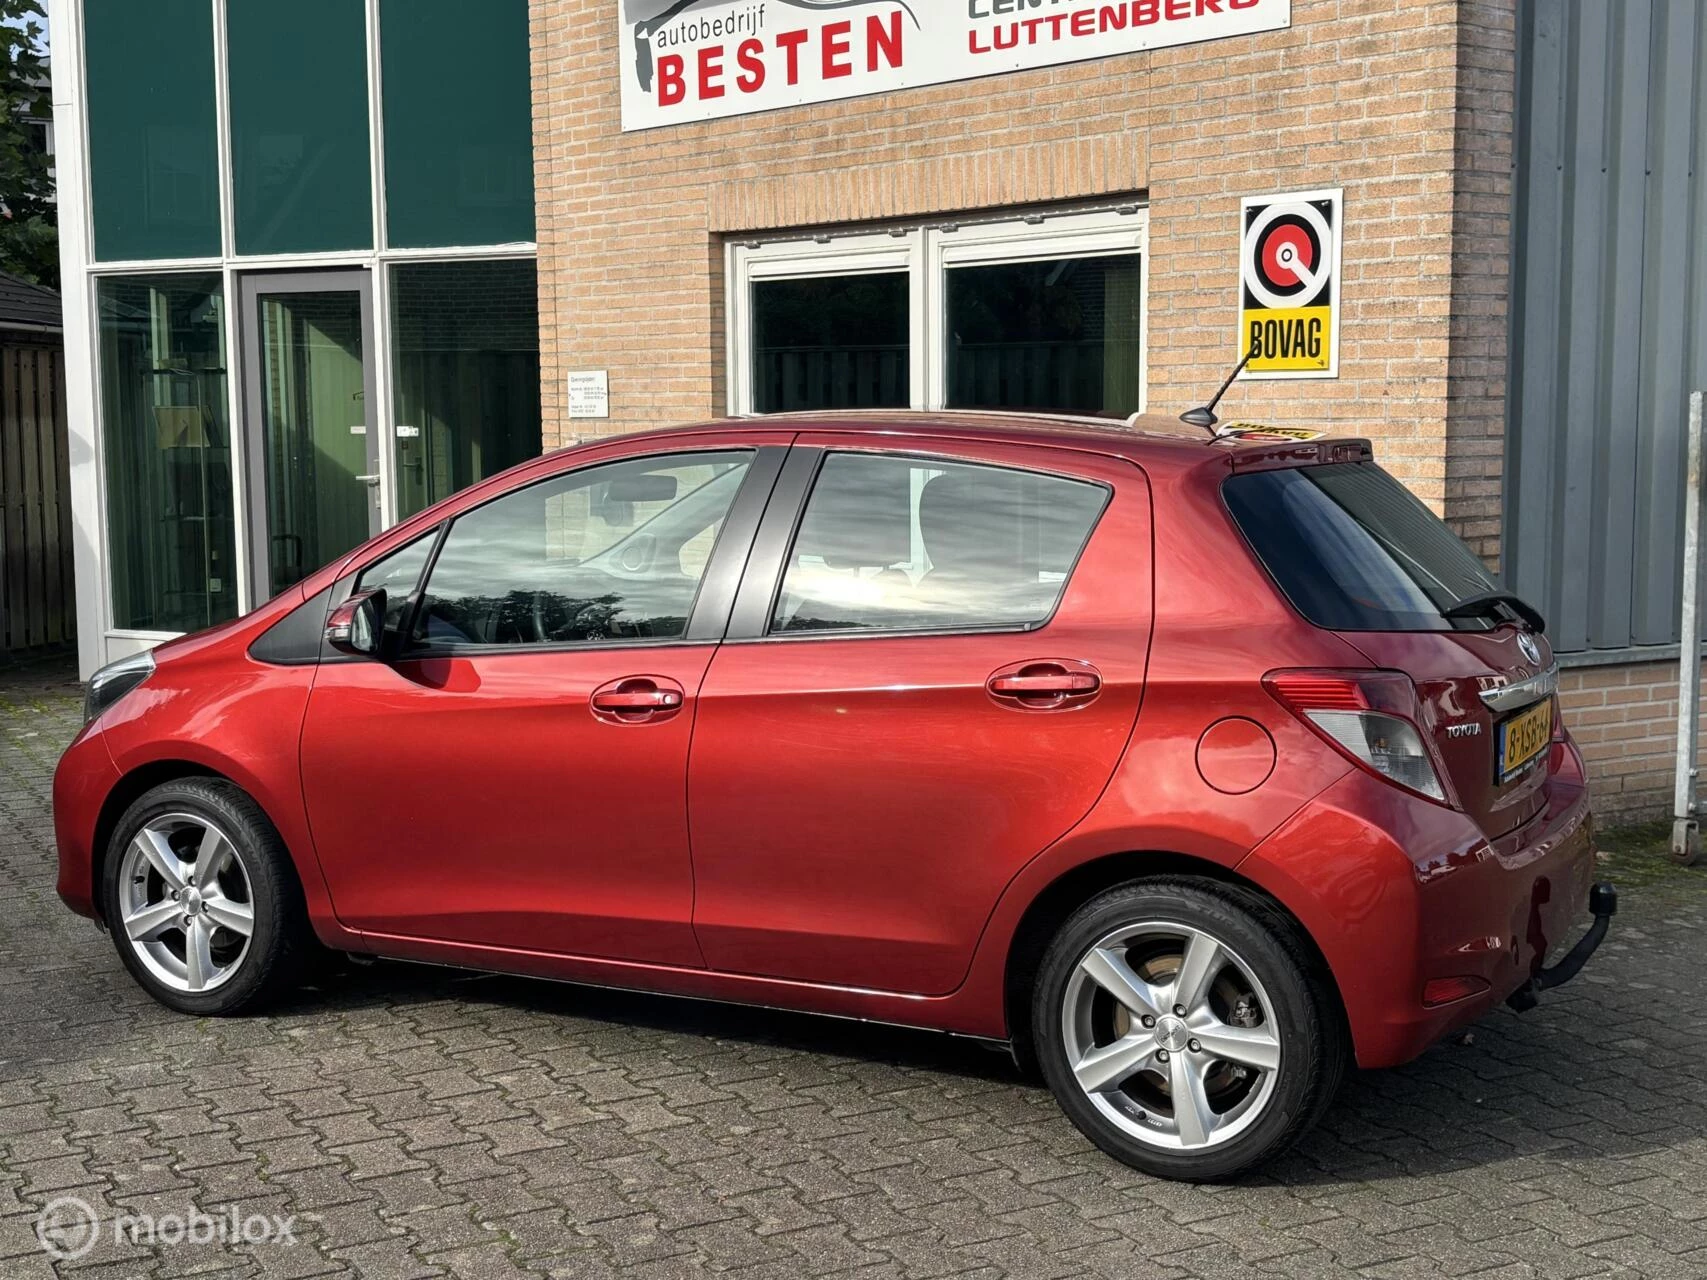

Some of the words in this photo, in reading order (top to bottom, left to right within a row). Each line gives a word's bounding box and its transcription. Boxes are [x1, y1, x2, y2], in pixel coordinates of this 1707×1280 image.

[657, 6, 765, 48] autobedrijf
[657, 10, 903, 107] BESTEN
[1250, 317, 1321, 359] BOVAG
[1446, 722, 1481, 738] TOYOTA
